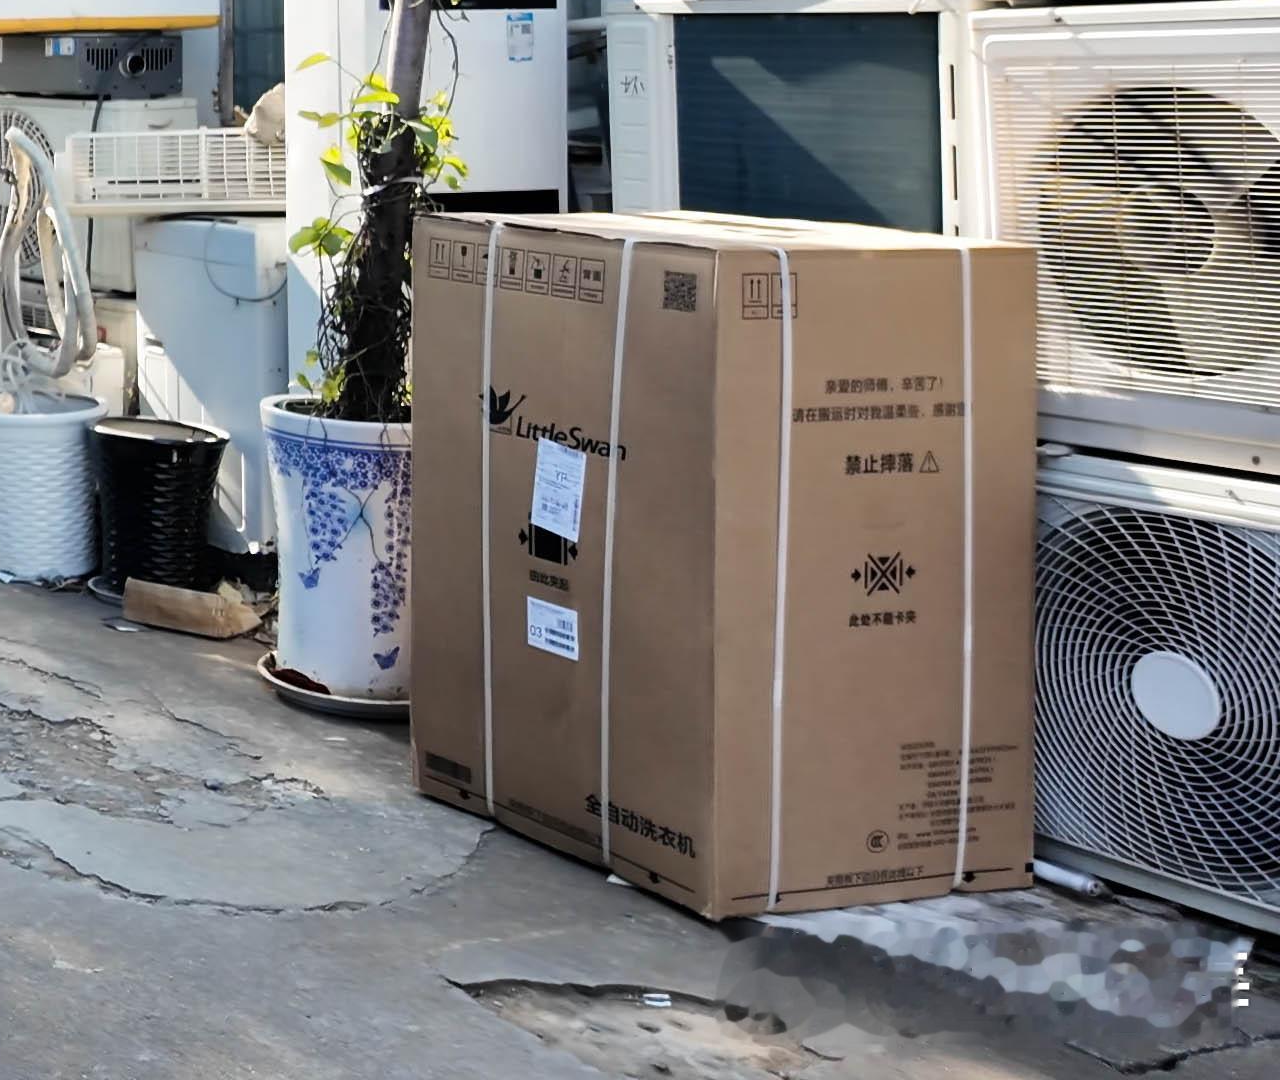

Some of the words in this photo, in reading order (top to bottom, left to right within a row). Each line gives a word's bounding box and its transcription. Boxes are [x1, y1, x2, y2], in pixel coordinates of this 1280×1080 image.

[515, 416, 627, 461] LittleSwan
[585, 793, 697, 859] 全自动洗衣机
